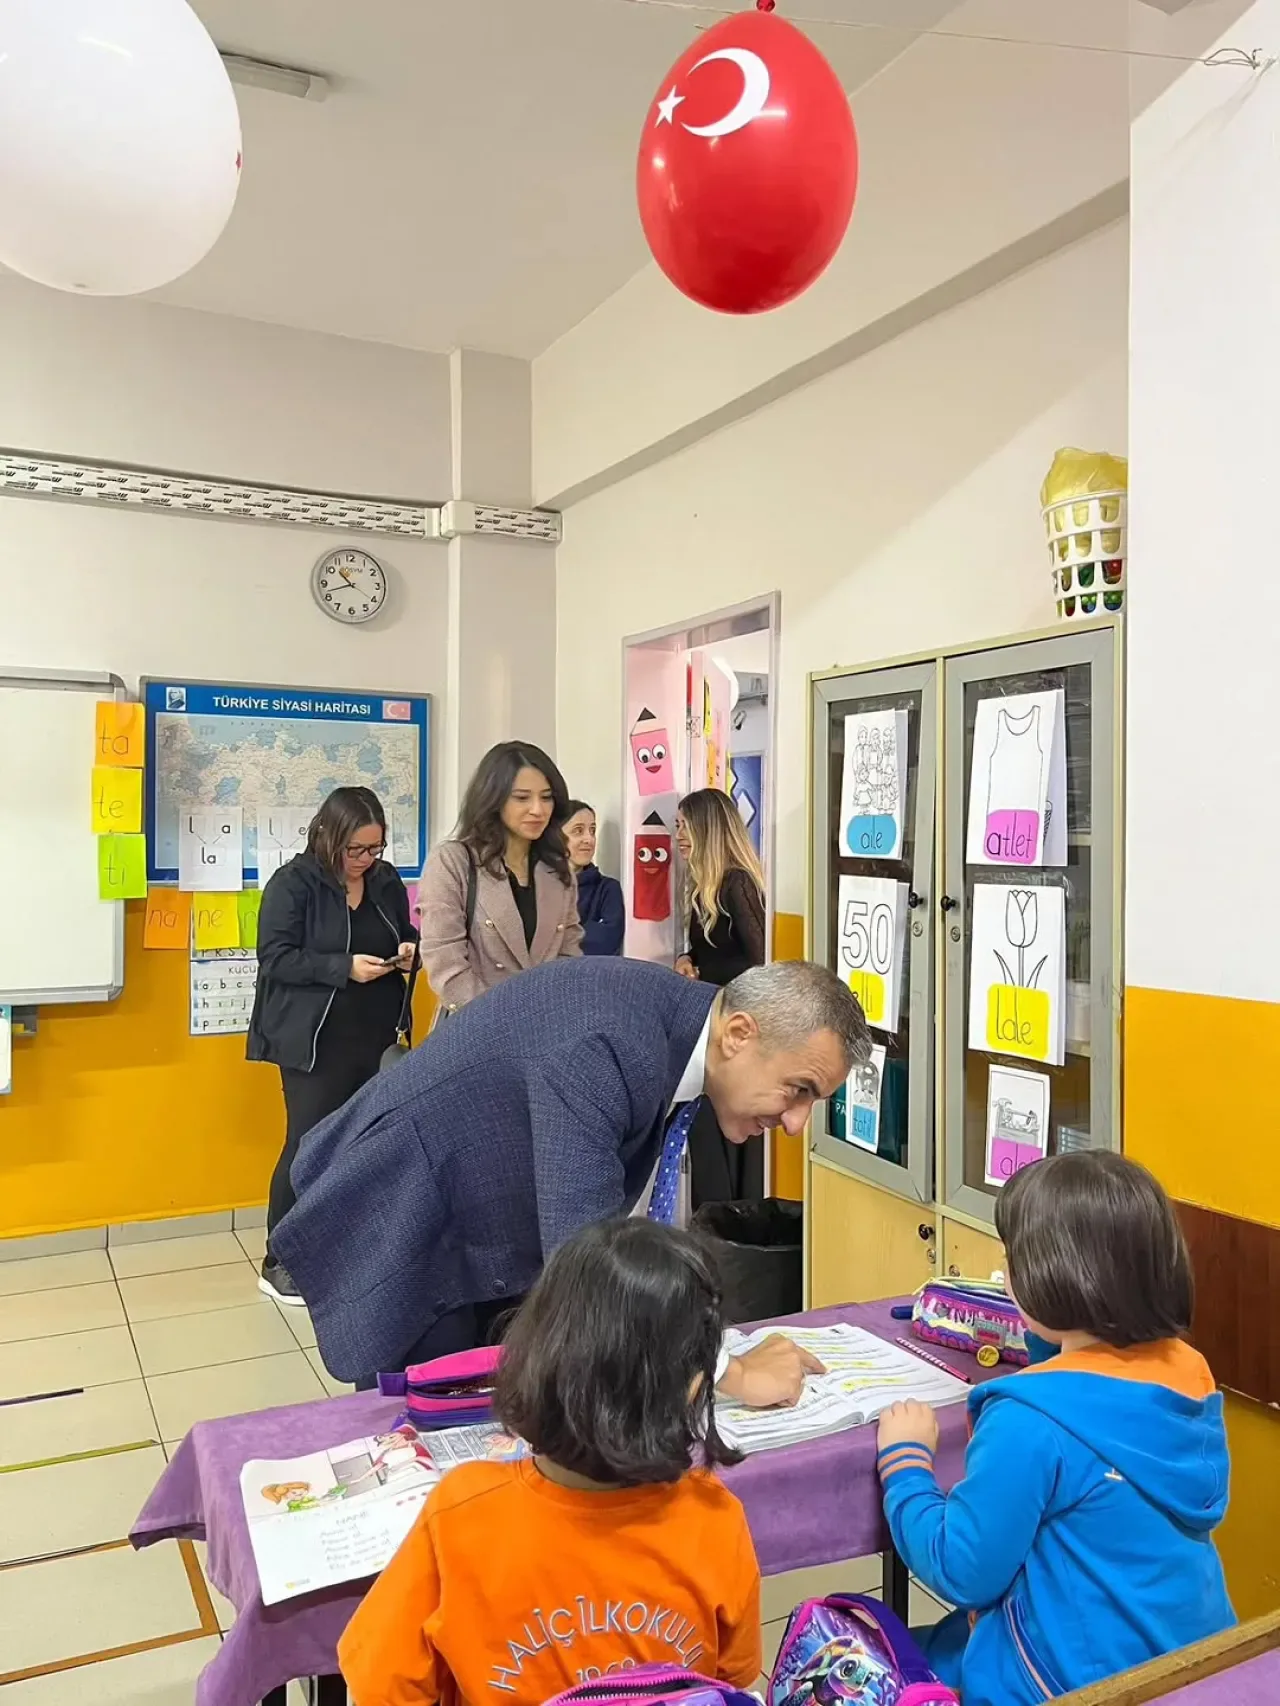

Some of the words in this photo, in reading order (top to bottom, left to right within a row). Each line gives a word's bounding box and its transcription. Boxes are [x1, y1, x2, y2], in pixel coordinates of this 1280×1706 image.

[334, 558, 340, 566] 11
[346, 554, 356, 563] 12
[326, 566, 336, 574] 10
[321, 580, 328, 588] 9
[325, 593, 332, 602] 8
[334, 603, 341, 611] 7
[348, 606, 356, 615] 6
[362, 604, 369, 612] 5
[213, 696, 269, 710] TÜRKİYE
[272, 698, 312, 712] SİYASİ
[315, 701, 371, 715] HARİTASI
[99, 720, 129, 755] ta
[94, 785, 124, 819] te
[221, 825, 231, 834] a
[298, 826, 307, 836] e
[987, 812, 1032, 858] atlet
[201, 847, 217, 864] la
[149, 909, 178, 928] na
[199, 909, 224, 928] ne
[842, 900, 894, 975] 50
[220, 978, 226, 989] b
[997, 988, 1034, 1045] lale
[487, 1608, 575, 1693] HALİÇ
[576, 1595, 704, 1668] İLKOKULU
